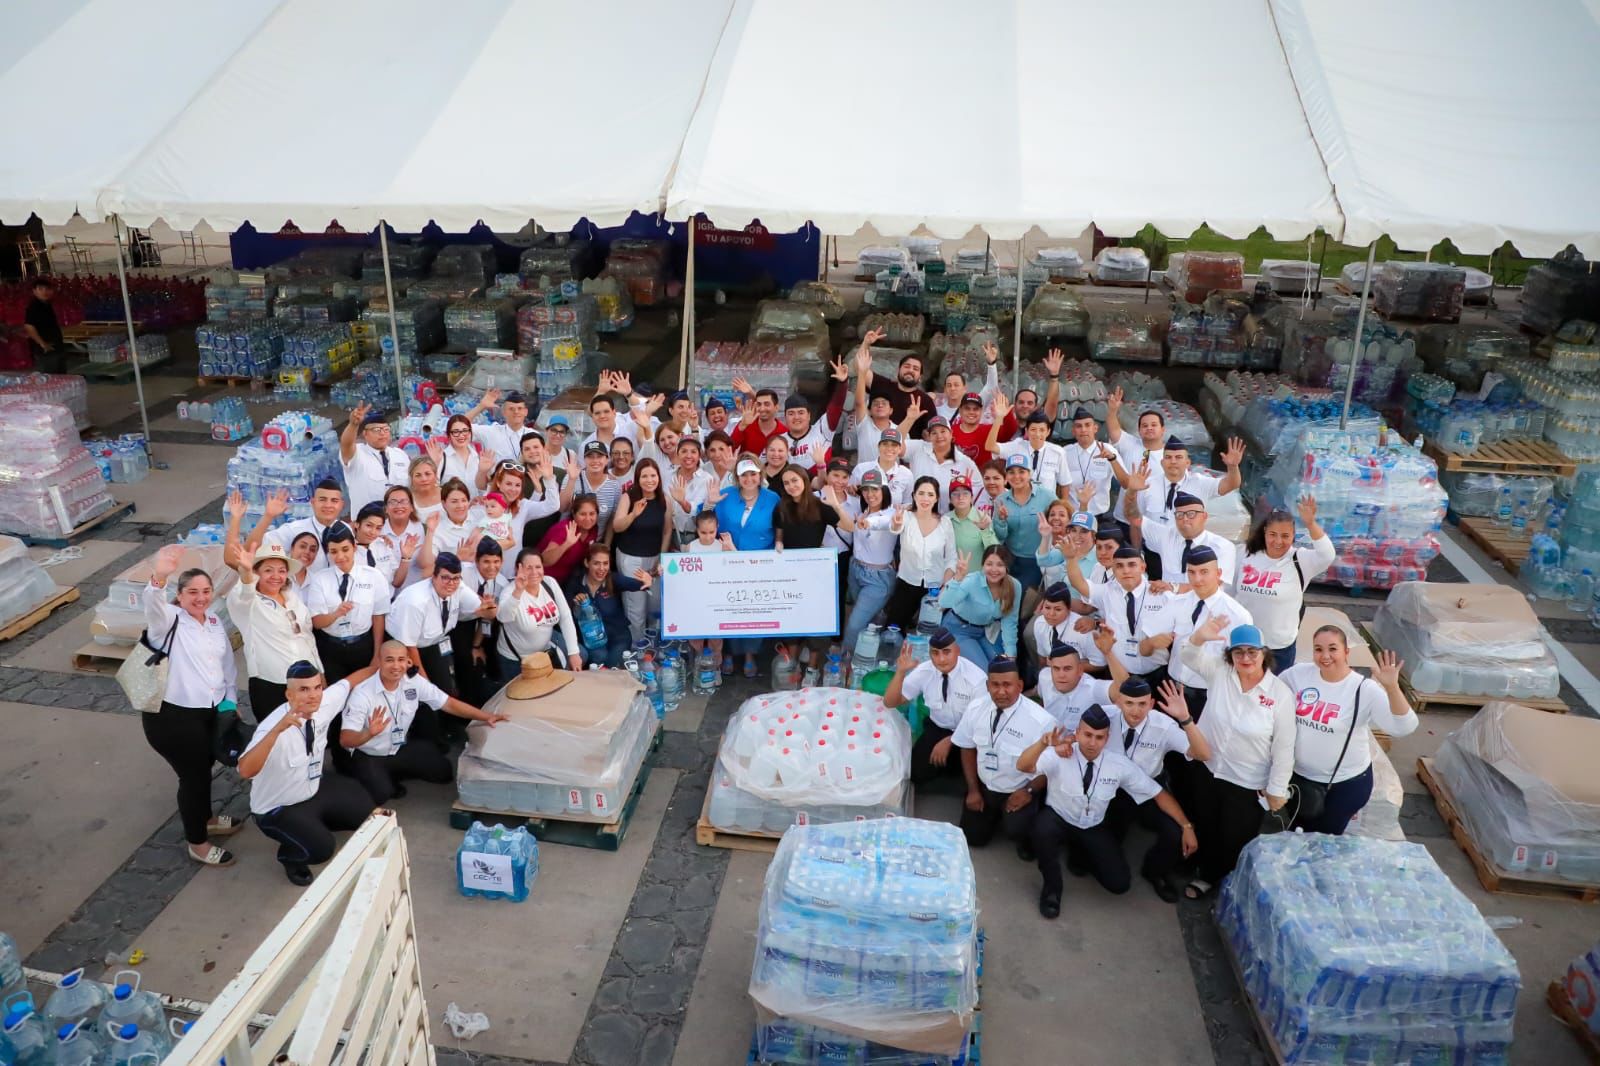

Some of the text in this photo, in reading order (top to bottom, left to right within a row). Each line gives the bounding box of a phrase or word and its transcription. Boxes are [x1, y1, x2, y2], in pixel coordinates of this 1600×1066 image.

[705, 234, 718, 243] TU
[679, 556, 703, 565] AQUA
[680, 563, 704, 572] TON
[1242, 565, 1281, 588] DIF
[1240, 584, 1278, 597] SINALOA
[529, 600, 558, 623] DIF
